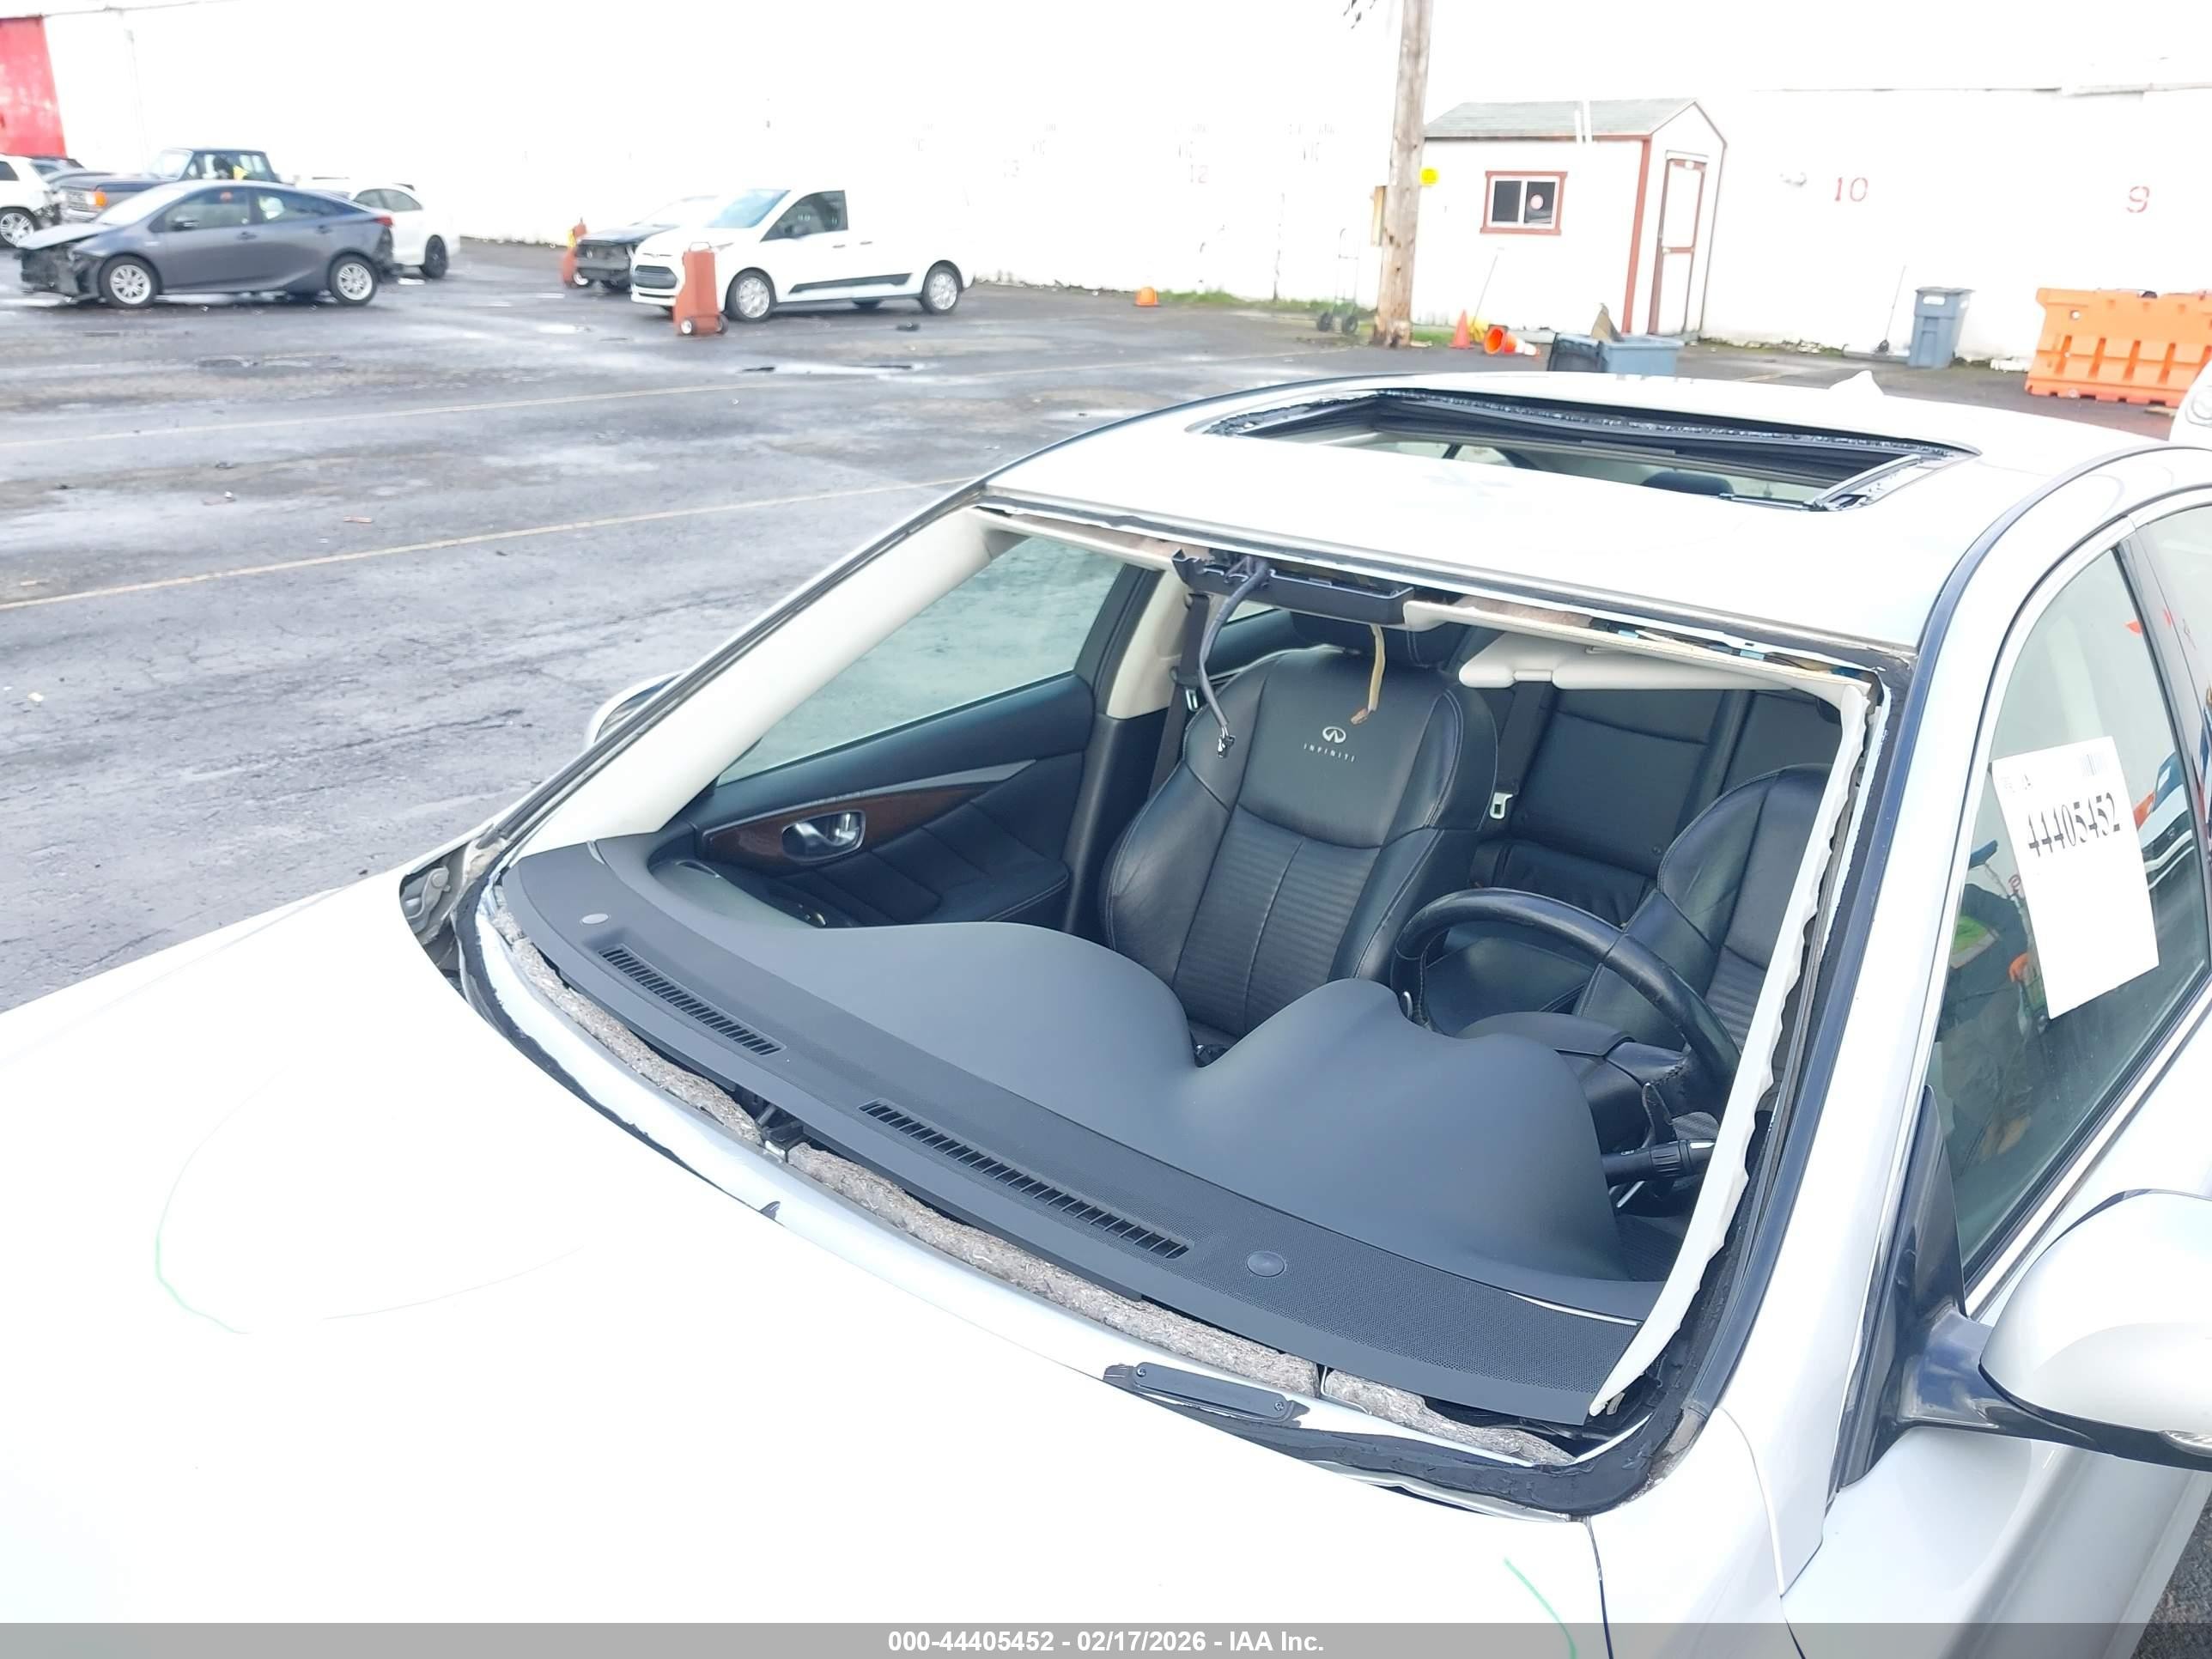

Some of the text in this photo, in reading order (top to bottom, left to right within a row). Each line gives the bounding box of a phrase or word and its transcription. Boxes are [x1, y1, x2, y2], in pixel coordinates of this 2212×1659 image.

[1834, 176, 1869, 203] 10
[2126, 185, 2150, 214] 9
[1304, 743, 1355, 763] INFINITI
[2027, 791, 2121, 858] 44405452
